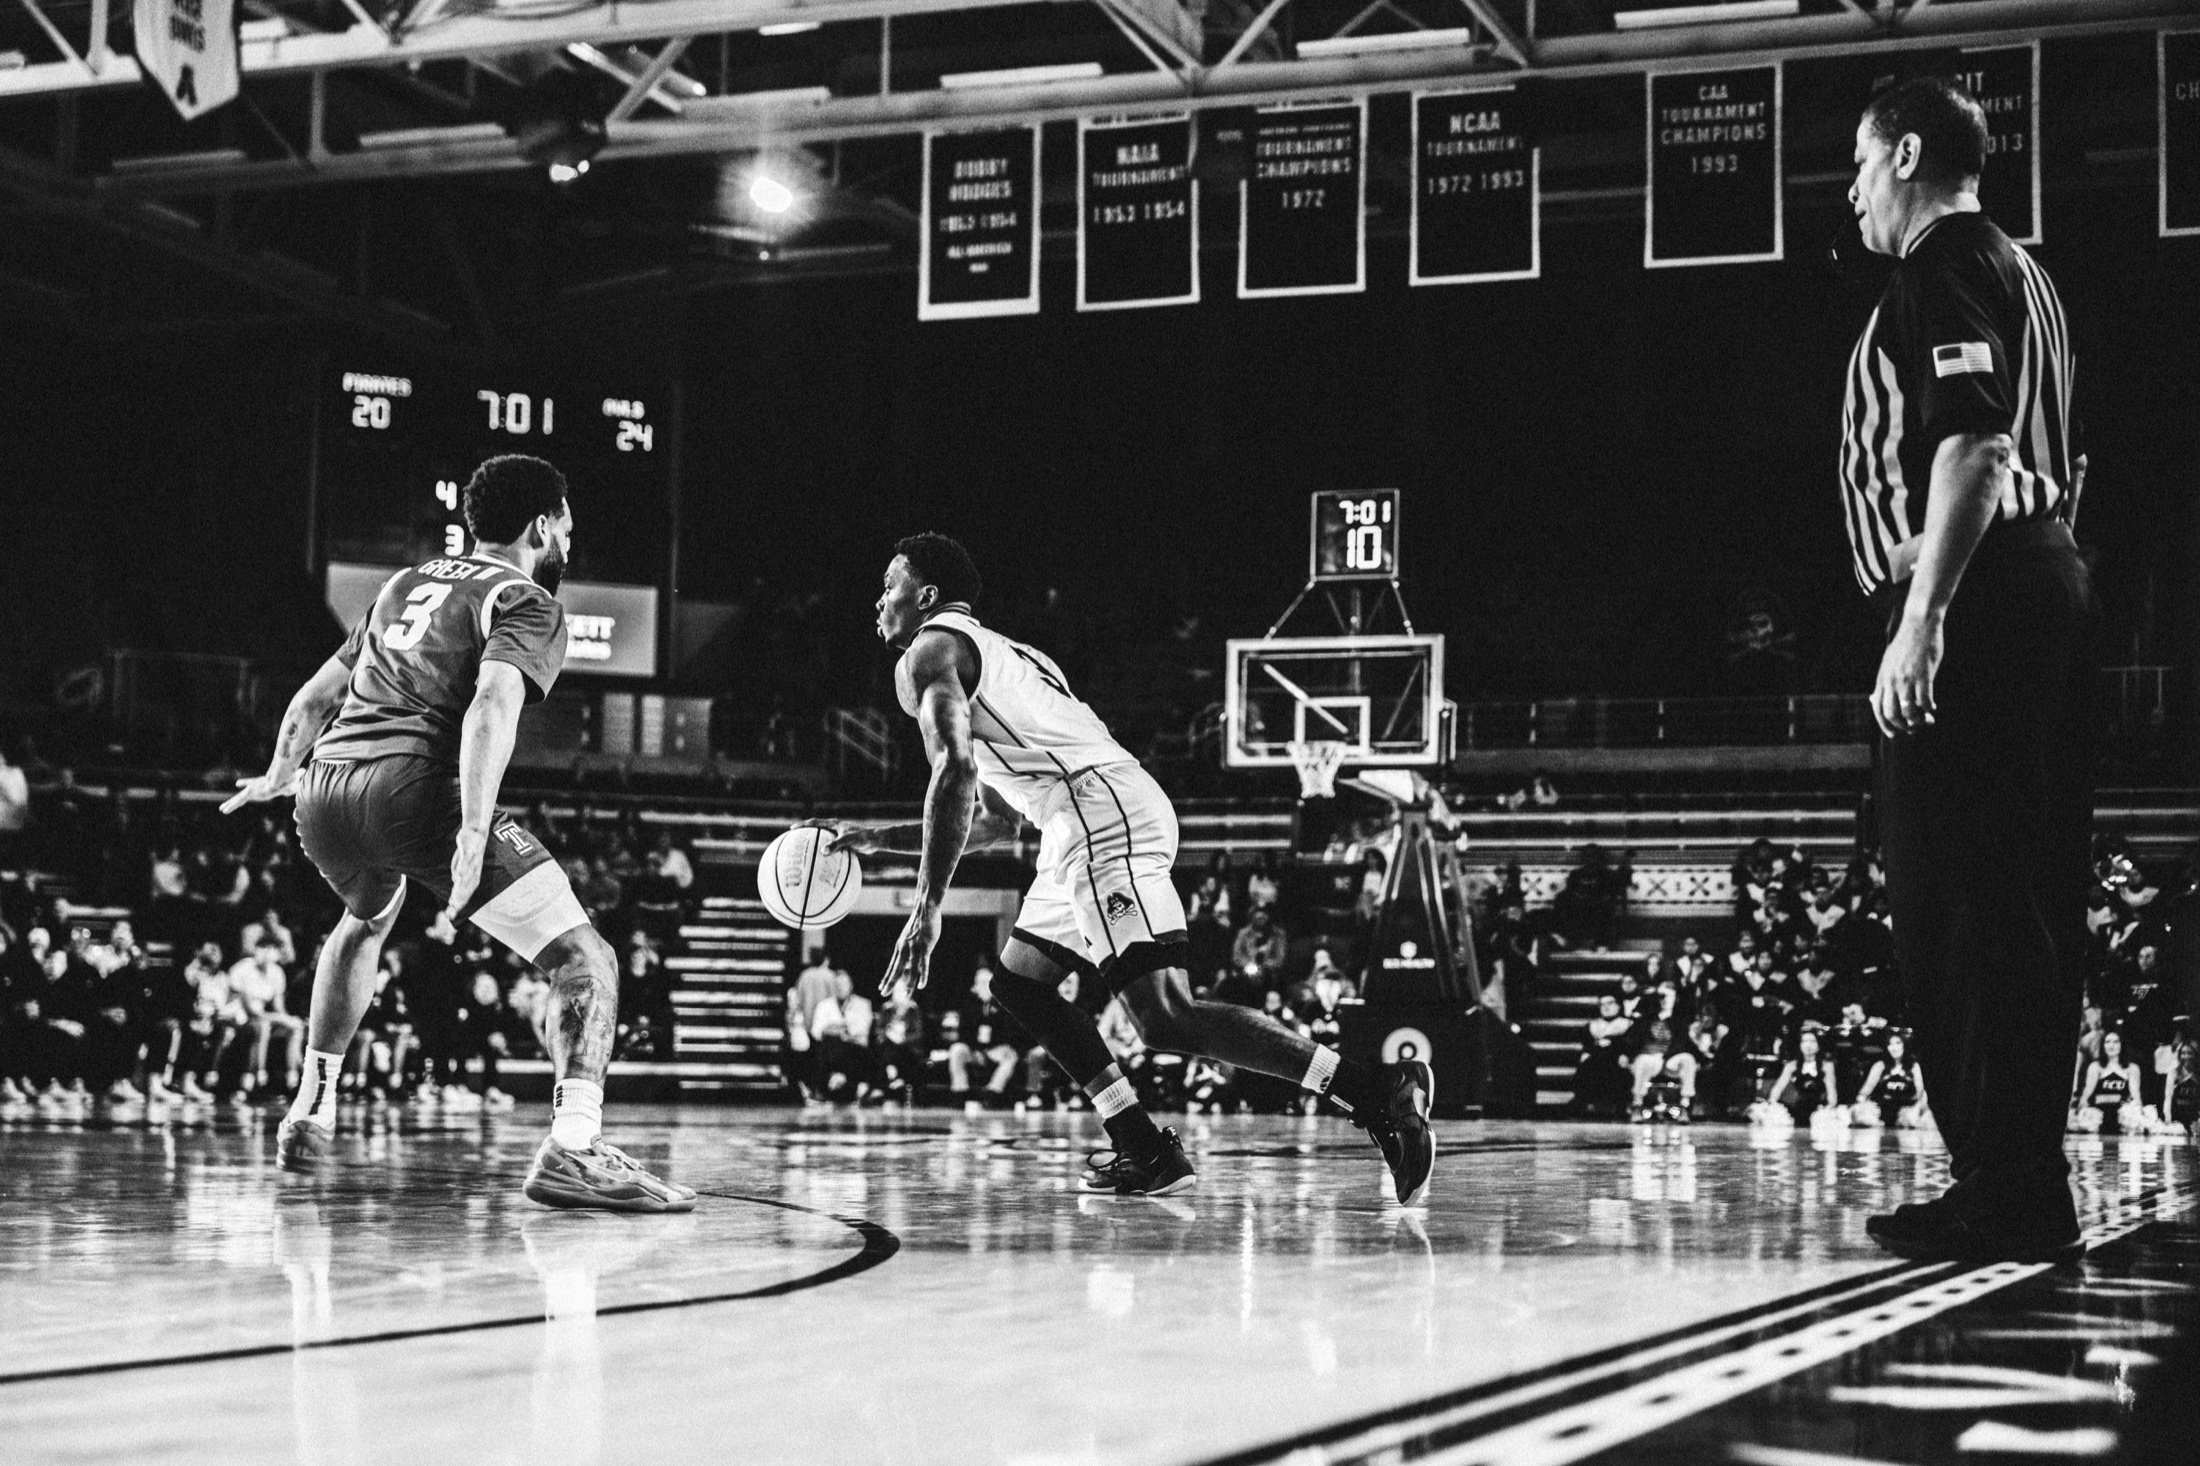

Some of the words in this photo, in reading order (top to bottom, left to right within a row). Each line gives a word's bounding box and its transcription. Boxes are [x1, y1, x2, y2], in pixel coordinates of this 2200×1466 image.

[1449, 111, 1500, 134] NCAA
[1663, 101, 1764, 122] TOURNAMENT
[1661, 122, 1766, 145] CHAMPIONS
[1692, 154, 1738, 173] 1993
[1428, 174, 1472, 195] 1972
[1481, 169, 1524, 190] 1993
[1282, 188, 1325, 209] 1972
[352, 394, 392, 429] 20
[615, 420, 653, 452] 24
[1338, 499, 1392, 525] 7:01
[1346, 525, 1383, 570] 10
[382, 581, 453, 652] 3
[493, 822, 533, 856] T
